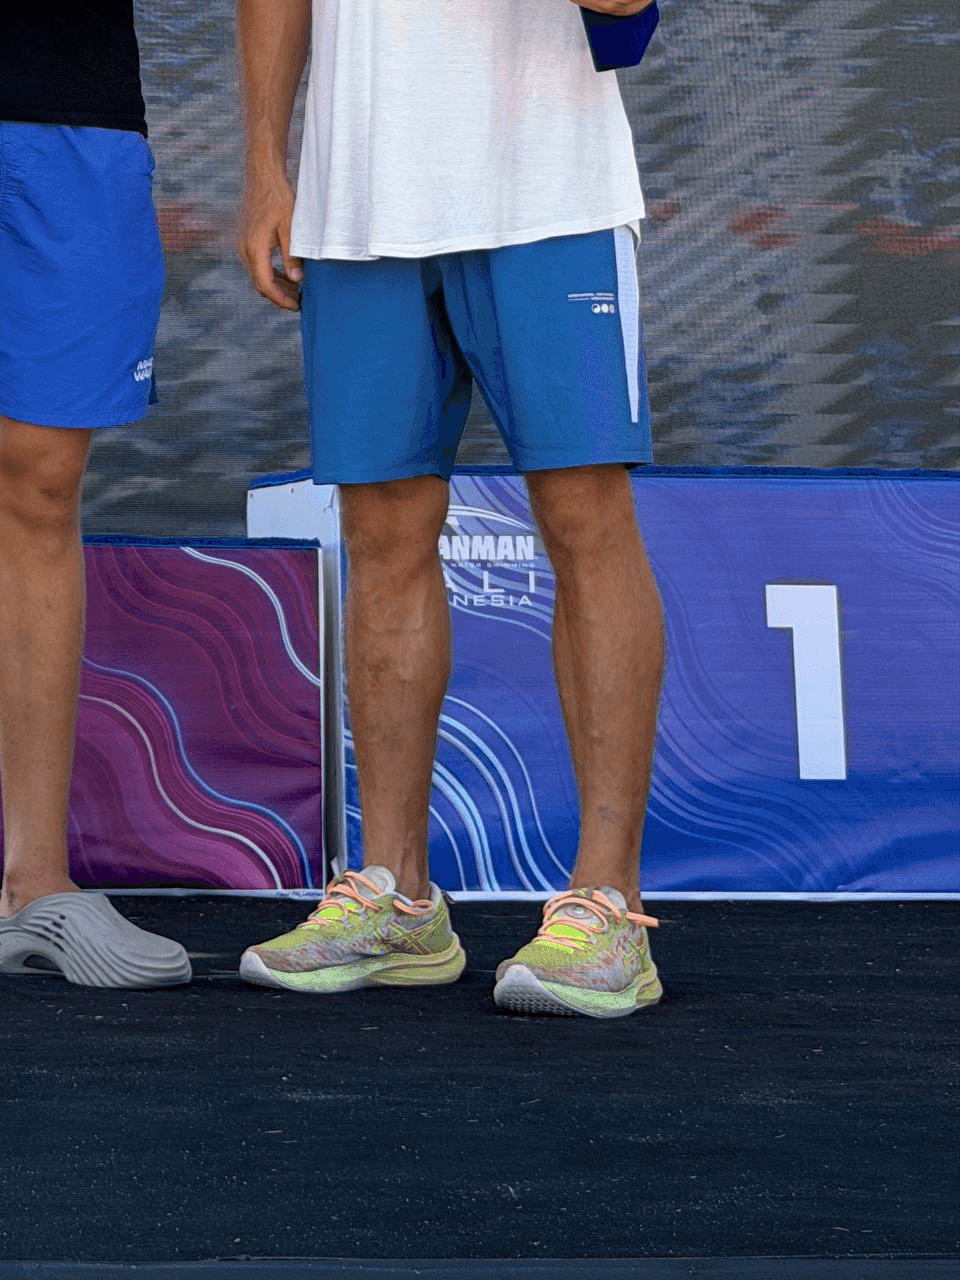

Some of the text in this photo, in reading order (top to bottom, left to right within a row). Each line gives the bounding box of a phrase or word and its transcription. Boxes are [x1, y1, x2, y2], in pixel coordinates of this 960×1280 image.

[438, 535, 534, 560] ANMAN
[452, 595, 533, 607] NESIA
[764, 584, 846, 780] 1
